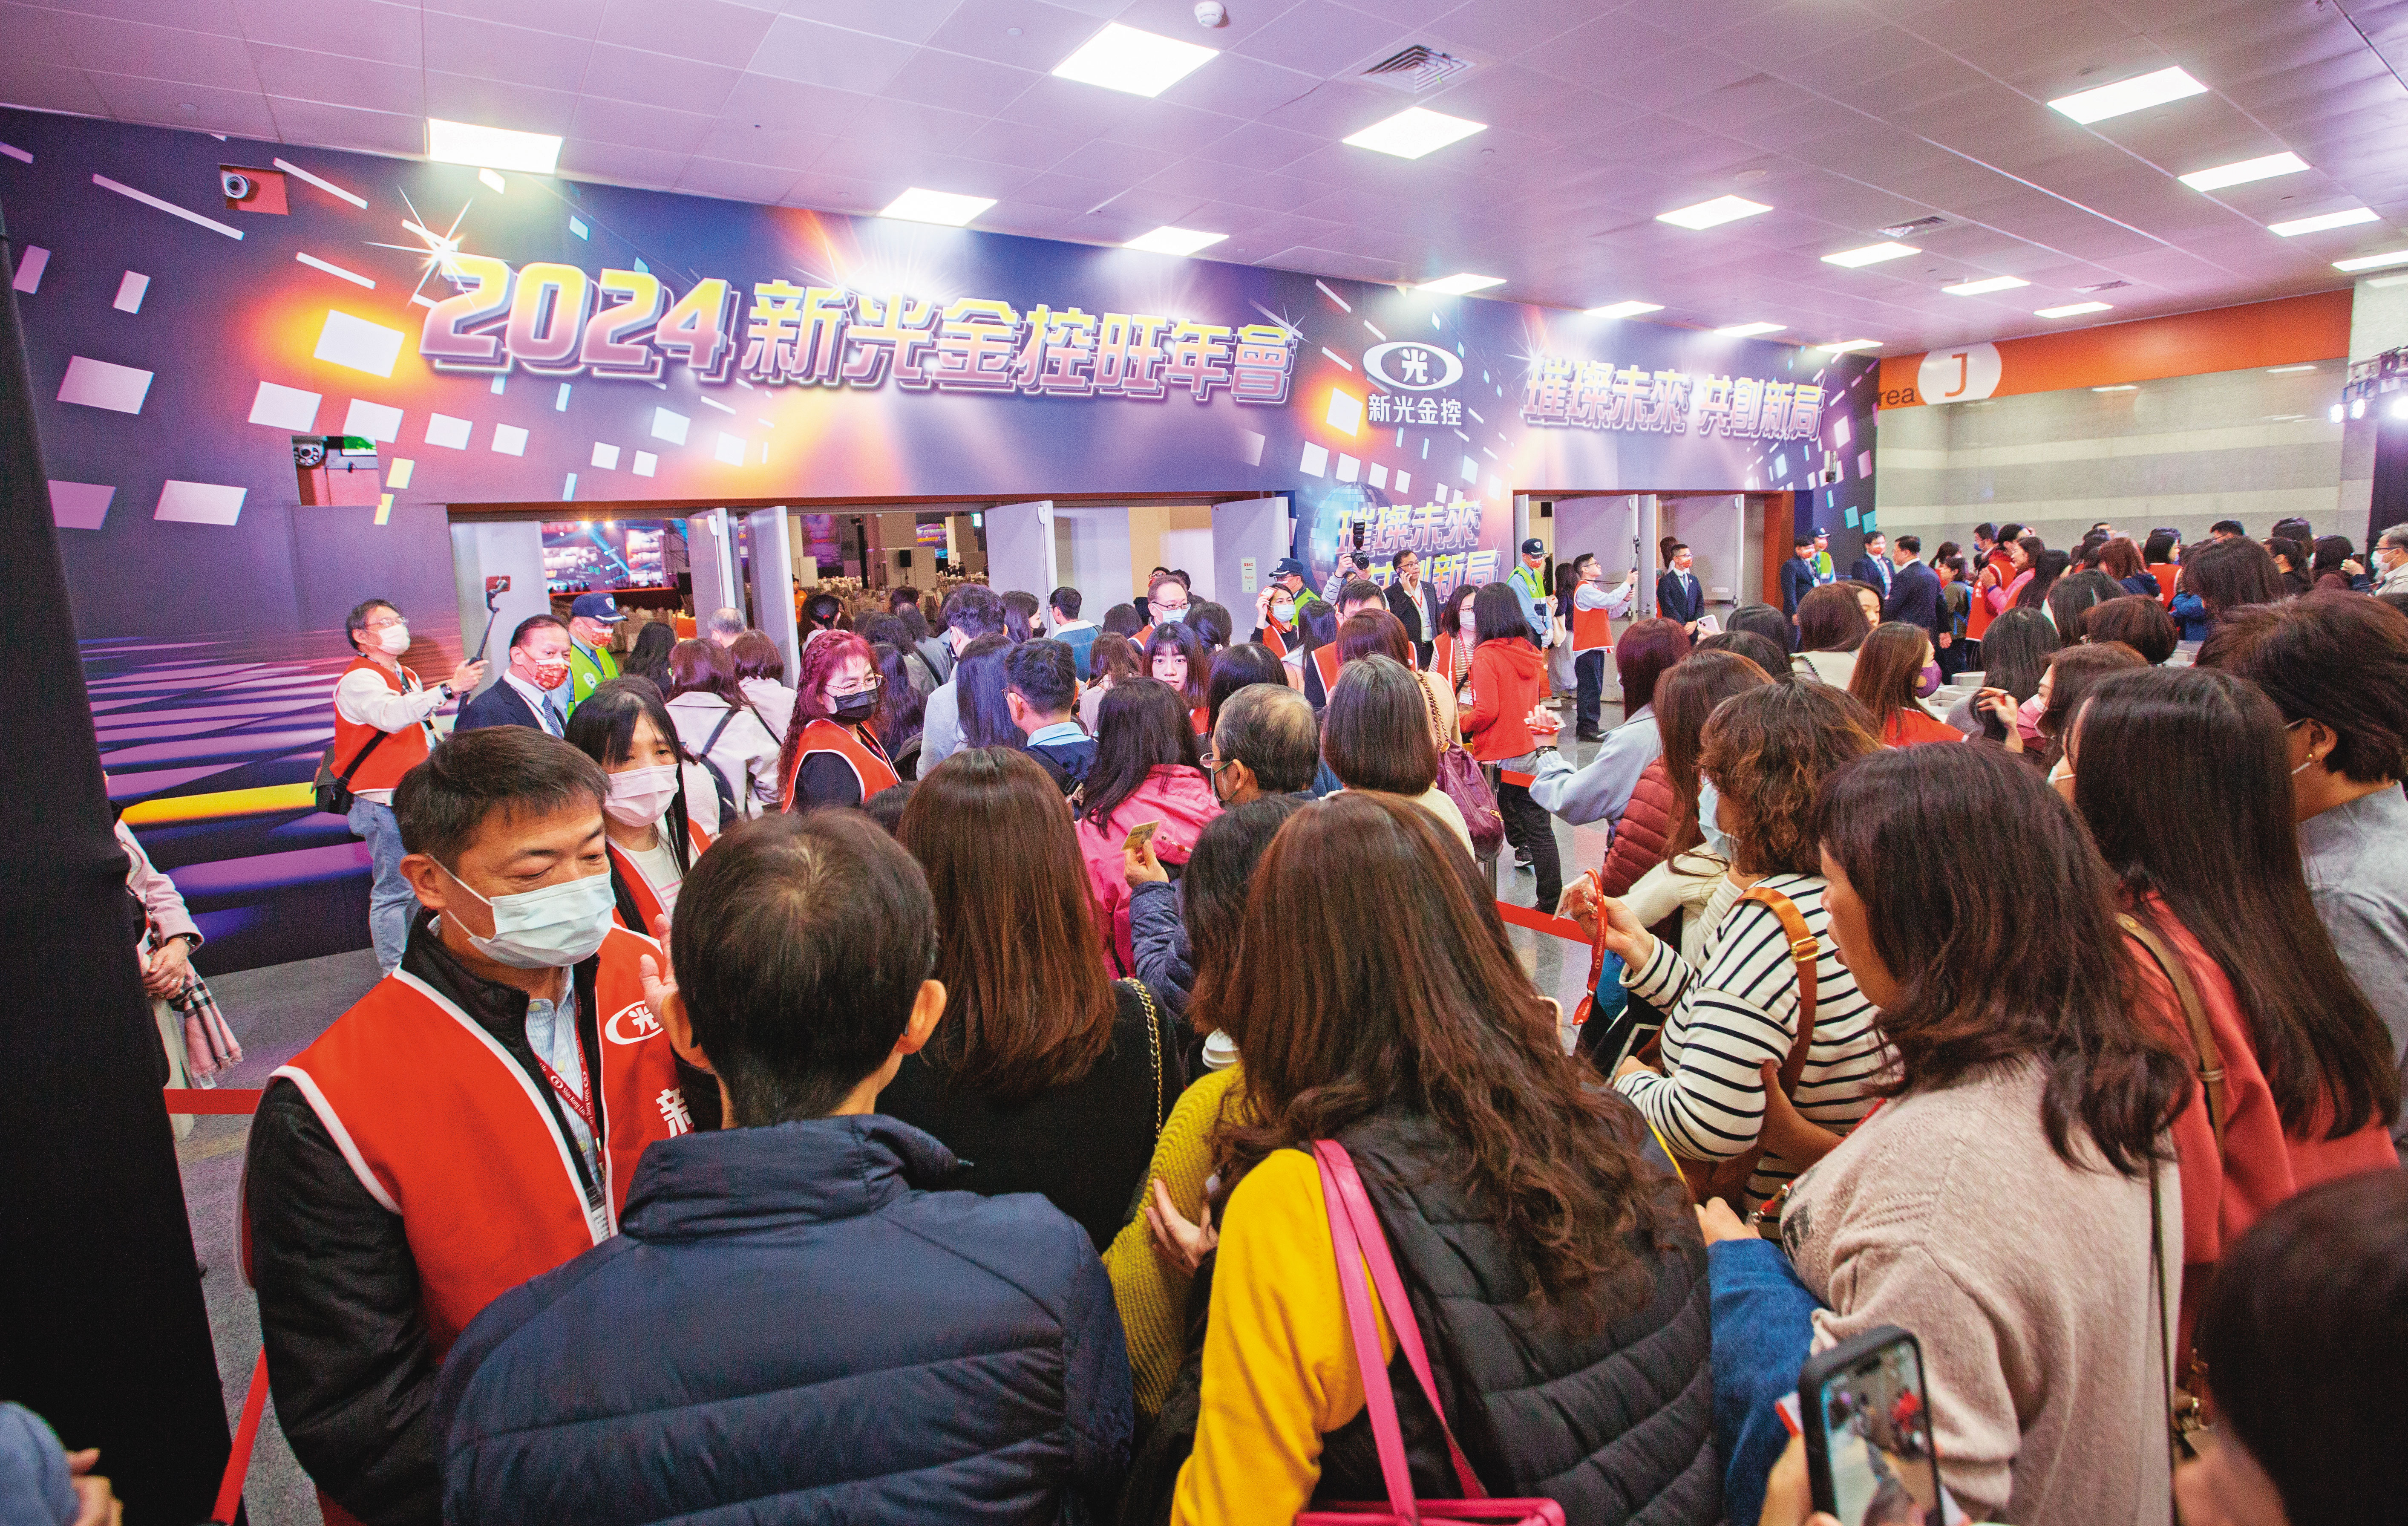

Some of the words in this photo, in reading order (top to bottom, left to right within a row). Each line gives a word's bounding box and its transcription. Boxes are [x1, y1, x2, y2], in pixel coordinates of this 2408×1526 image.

[1878, 387, 1915, 407] rea
[1945, 353, 1968, 397] J
[1368, 393, 1462, 426] 新光金控
[1698, 373, 1825, 441] 共創新局
[562, 1087, 571, 1099] Shin
[569, 1096, 580, 1110] Kong
